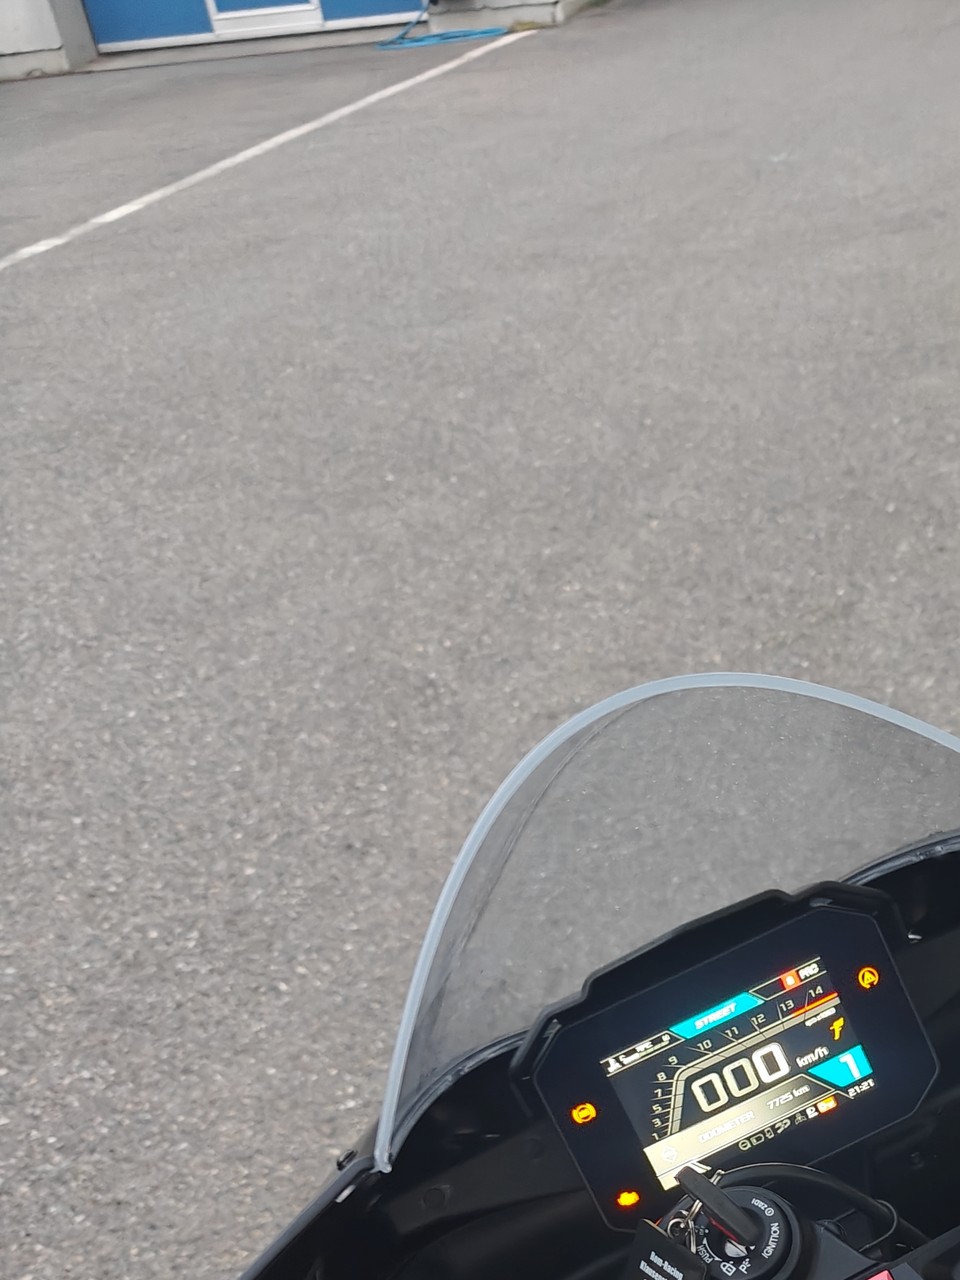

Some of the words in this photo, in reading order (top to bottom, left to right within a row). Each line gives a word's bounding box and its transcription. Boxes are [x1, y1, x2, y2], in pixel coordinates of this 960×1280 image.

[808, 986, 823, 998] 14
[780, 1000, 795, 1012] 13
[694, 1003, 736, 1030] STREET
[751, 1014, 767, 1025] 12
[725, 1027, 739, 1037] 11
[697, 1039, 712, 1051] 10
[668, 1056, 678, 1065] 9
[796, 1045, 830, 1067] km/h
[839, 1053, 861, 1081] 1
[656, 1072, 667, 1081] 8
[691, 1042, 791, 1112] 000
[653, 1088, 663, 1097] 7
[652, 1104, 663, 1113] 5
[698, 1111, 755, 1142] ODOMETER
[767, 1092, 793, 1110] 7725
[792, 1084, 811, 1097] km
[652, 1118, 662, 1128] 3
[651, 1132, 660, 1141] 1
[761, 1222, 780, 1259] IGNITION
[697, 1245, 713, 1264] PUSH
